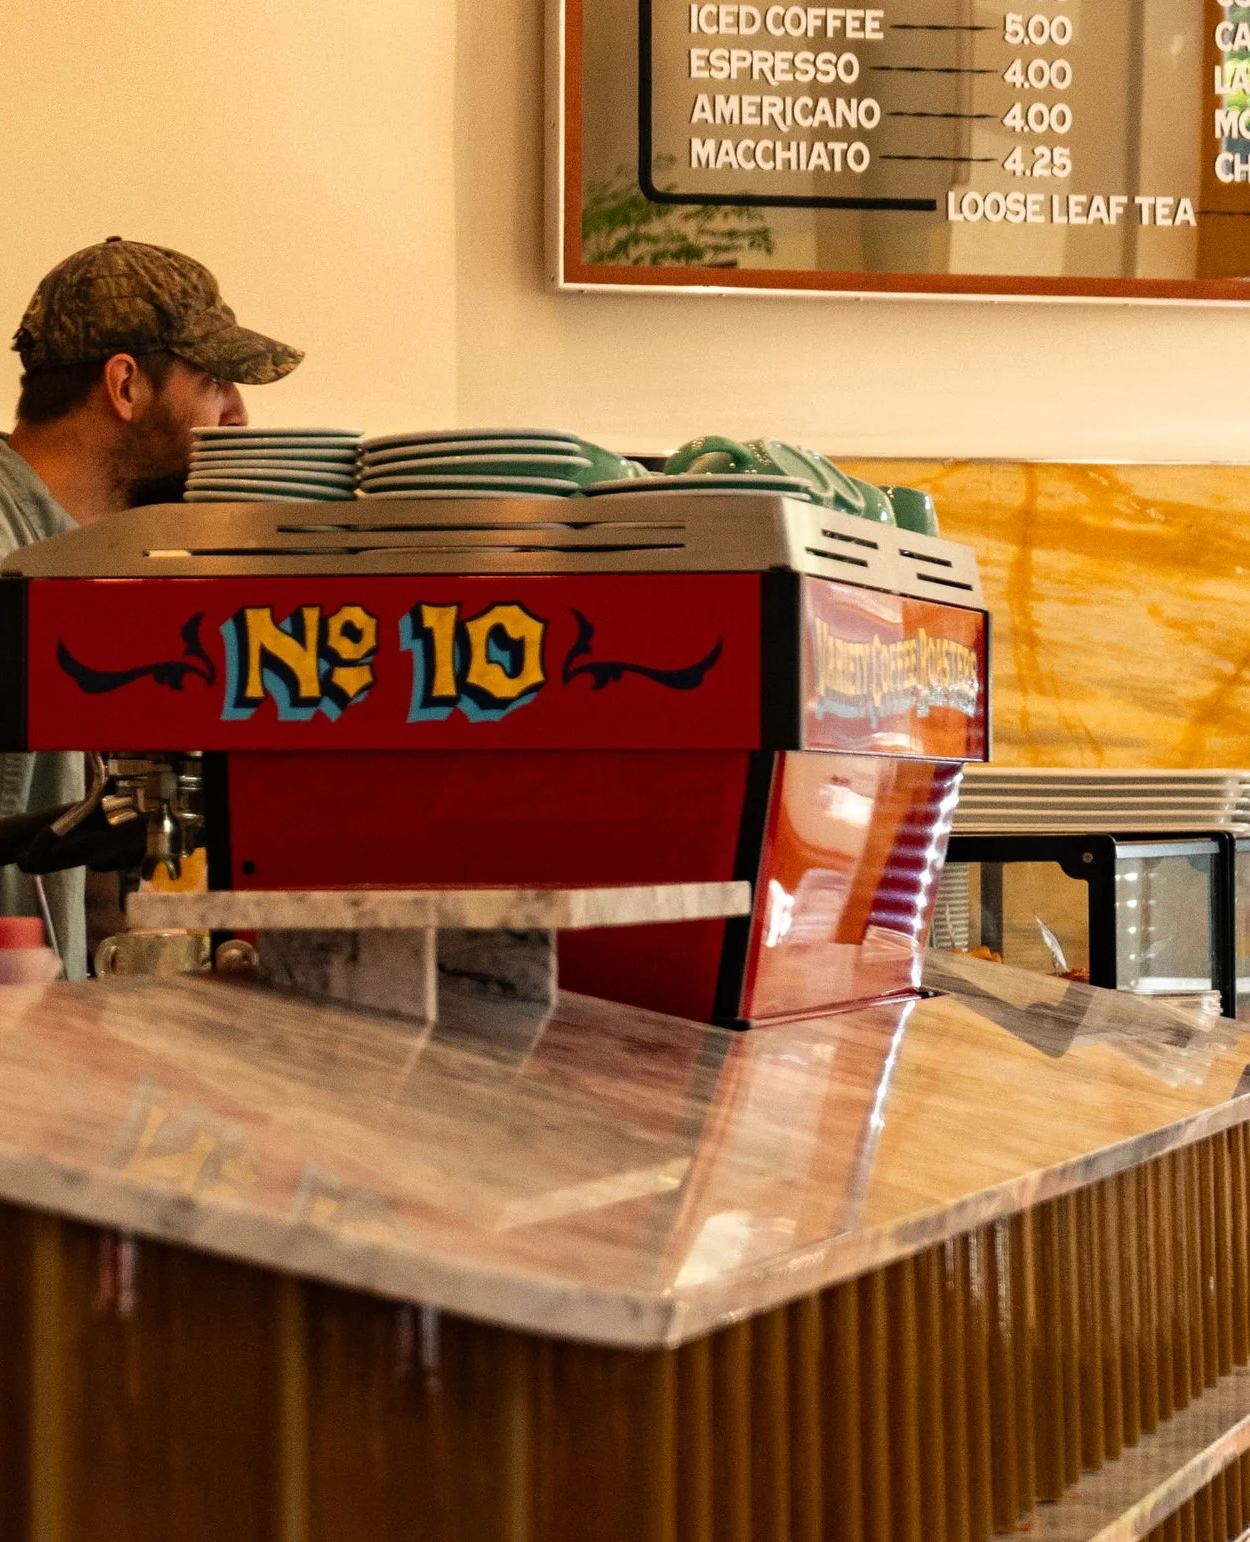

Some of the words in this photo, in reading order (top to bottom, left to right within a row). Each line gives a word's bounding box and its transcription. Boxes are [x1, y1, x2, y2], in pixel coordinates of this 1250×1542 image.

[690, 3, 761, 35] ICED
[765, 5, 884, 40] COFFEE
[1004, 12, 1072, 46] 5.00
[690, 48, 859, 86] ESPRESSO
[1003, 57, 1072, 90] 4.00
[690, 93, 881, 133] AMERICANO
[1002, 102, 1072, 134] 4.00
[690, 137, 870, 173] MACCHIATO
[1003, 145, 1072, 178] 4.25
[947, 190, 1045, 223] LOOSE
[1051, 193, 1127, 225] LEAF
[1135, 196, 1197, 227] TEA
[402, 600, 547, 718] 10
